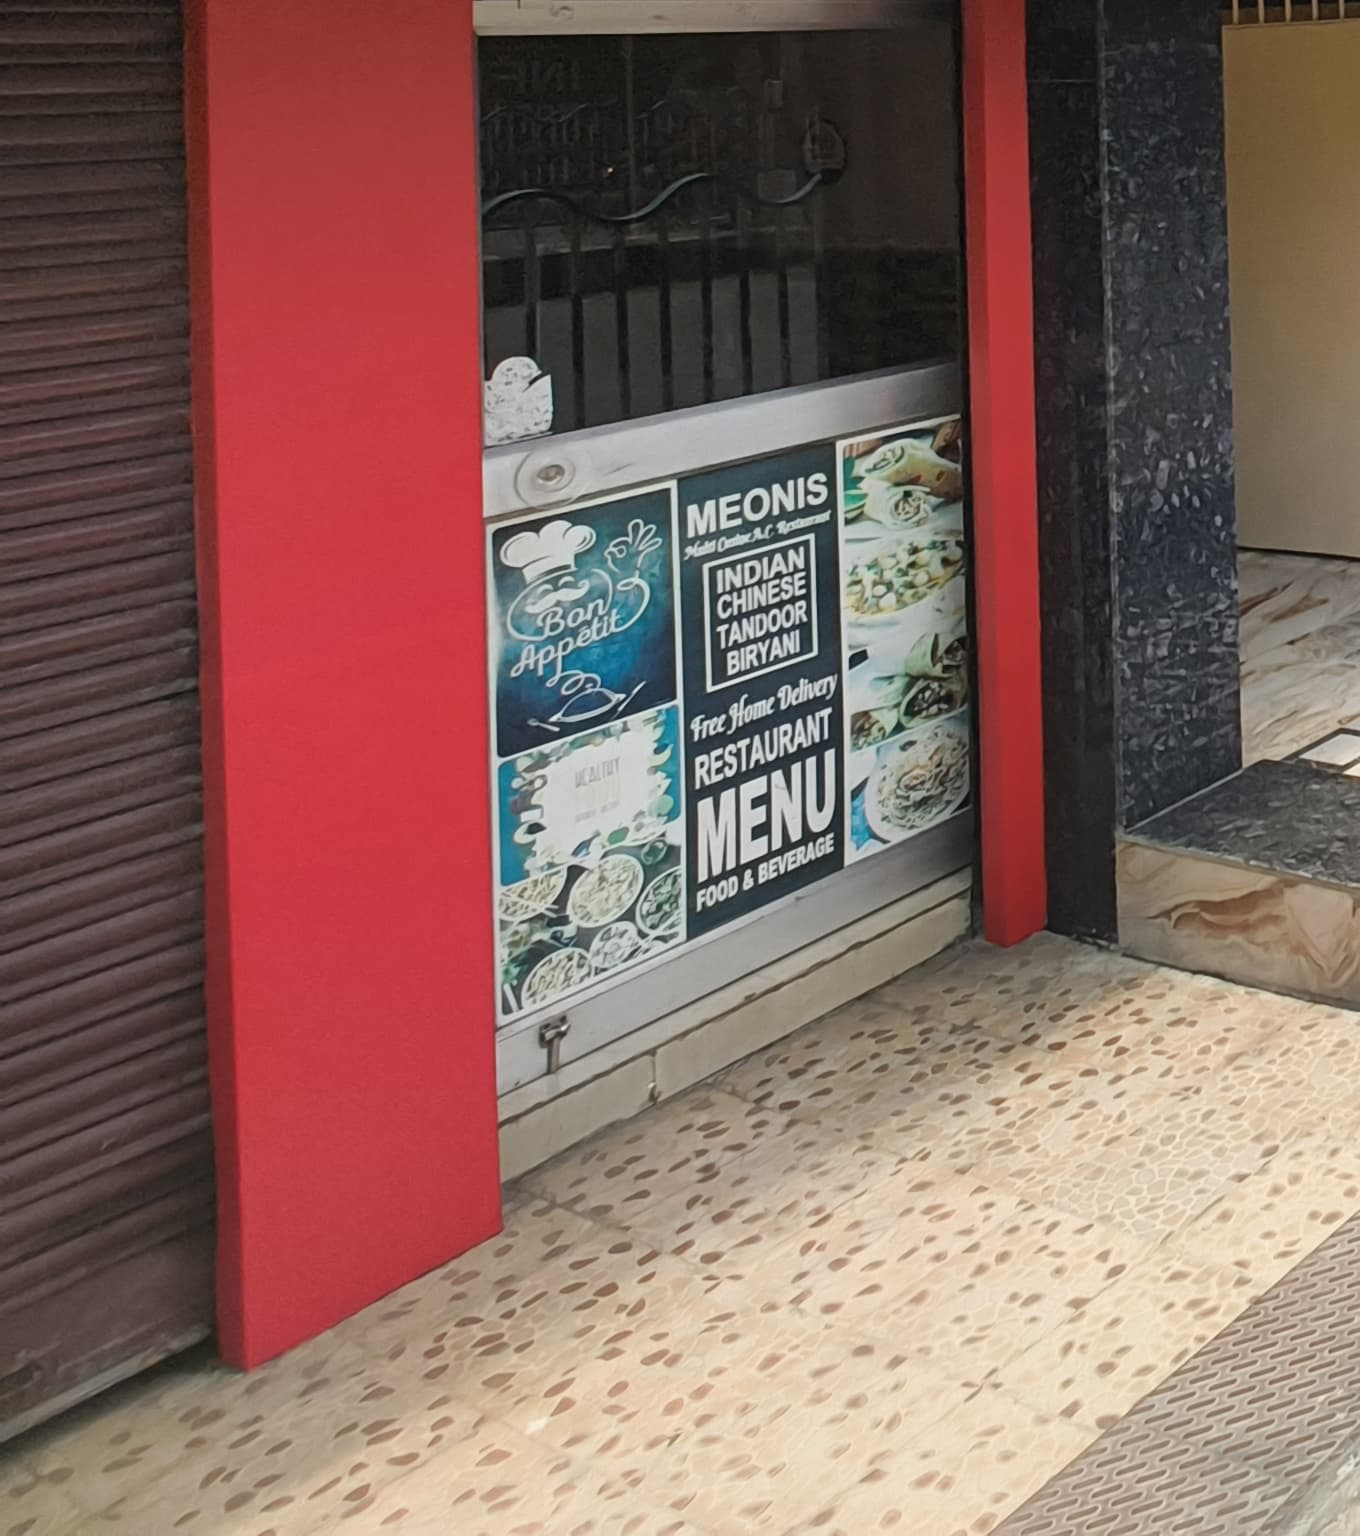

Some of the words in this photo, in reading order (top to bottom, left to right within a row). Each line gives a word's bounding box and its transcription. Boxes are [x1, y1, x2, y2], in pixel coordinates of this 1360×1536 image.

[686, 472, 829, 539] MEONIS
[716, 545, 805, 595] INDIAN
[717, 571, 807, 620] CHINESE
[536, 598, 607, 639] Bon
[716, 600, 808, 650] TANDOOR
[726, 629, 800, 676] BIRYANI
[690, 713, 727, 743] Free
[727, 694, 776, 735] Home
[776, 673, 838, 711] Delivery
[694, 707, 833, 791] RESTAURANT
[697, 747, 836, 884] MENU
[696, 875, 738, 912] FOOD
[742, 868, 754, 892] &
[758, 832, 835, 885] BEVERAGE
